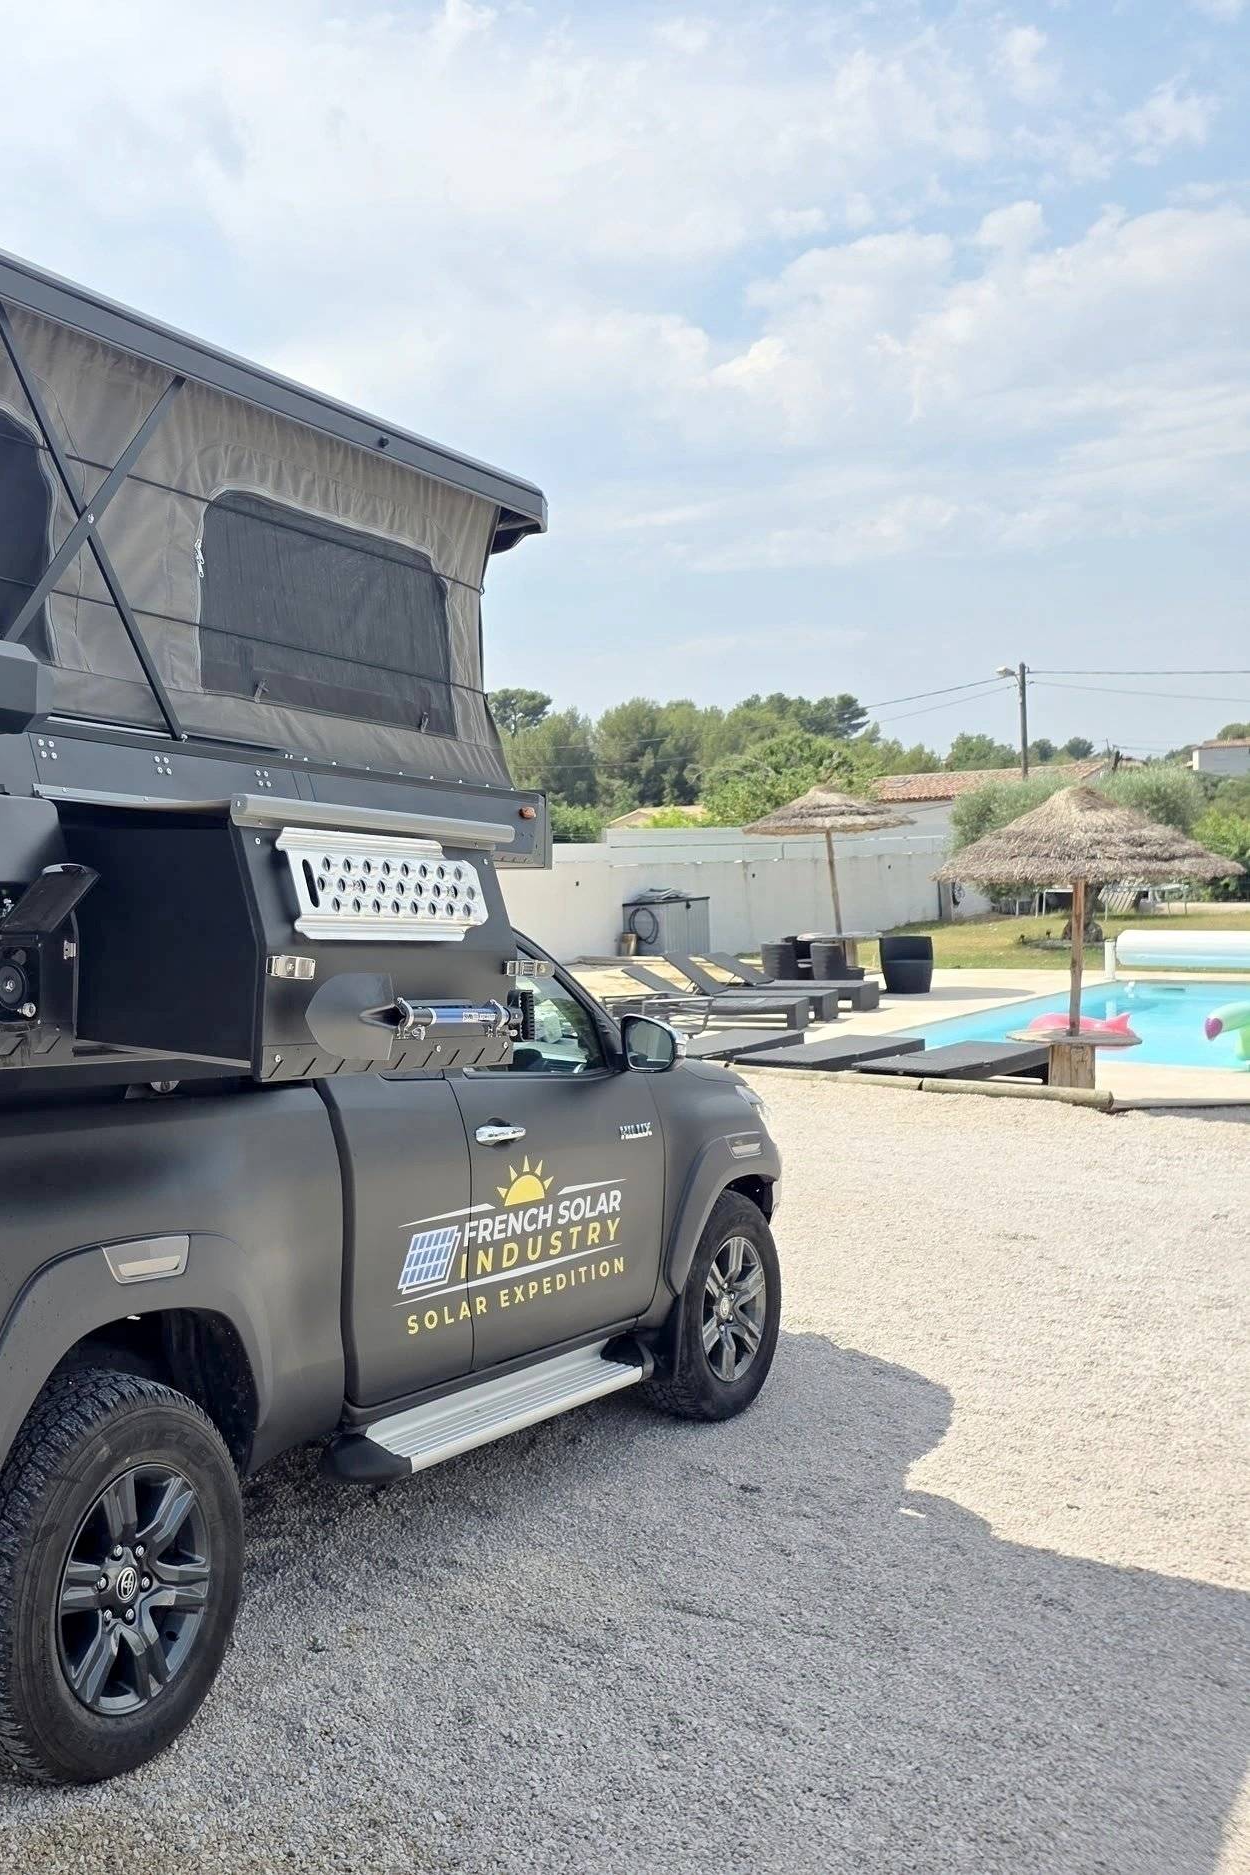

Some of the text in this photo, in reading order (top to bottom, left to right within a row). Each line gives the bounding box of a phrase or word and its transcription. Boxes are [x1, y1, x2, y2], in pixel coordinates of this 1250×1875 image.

[460, 1217, 621, 1279] INDUSTRY
[463, 1189, 622, 1247] FRENCH SOLAR
[407, 1256, 625, 1335] SOLAR EXPEDITION
